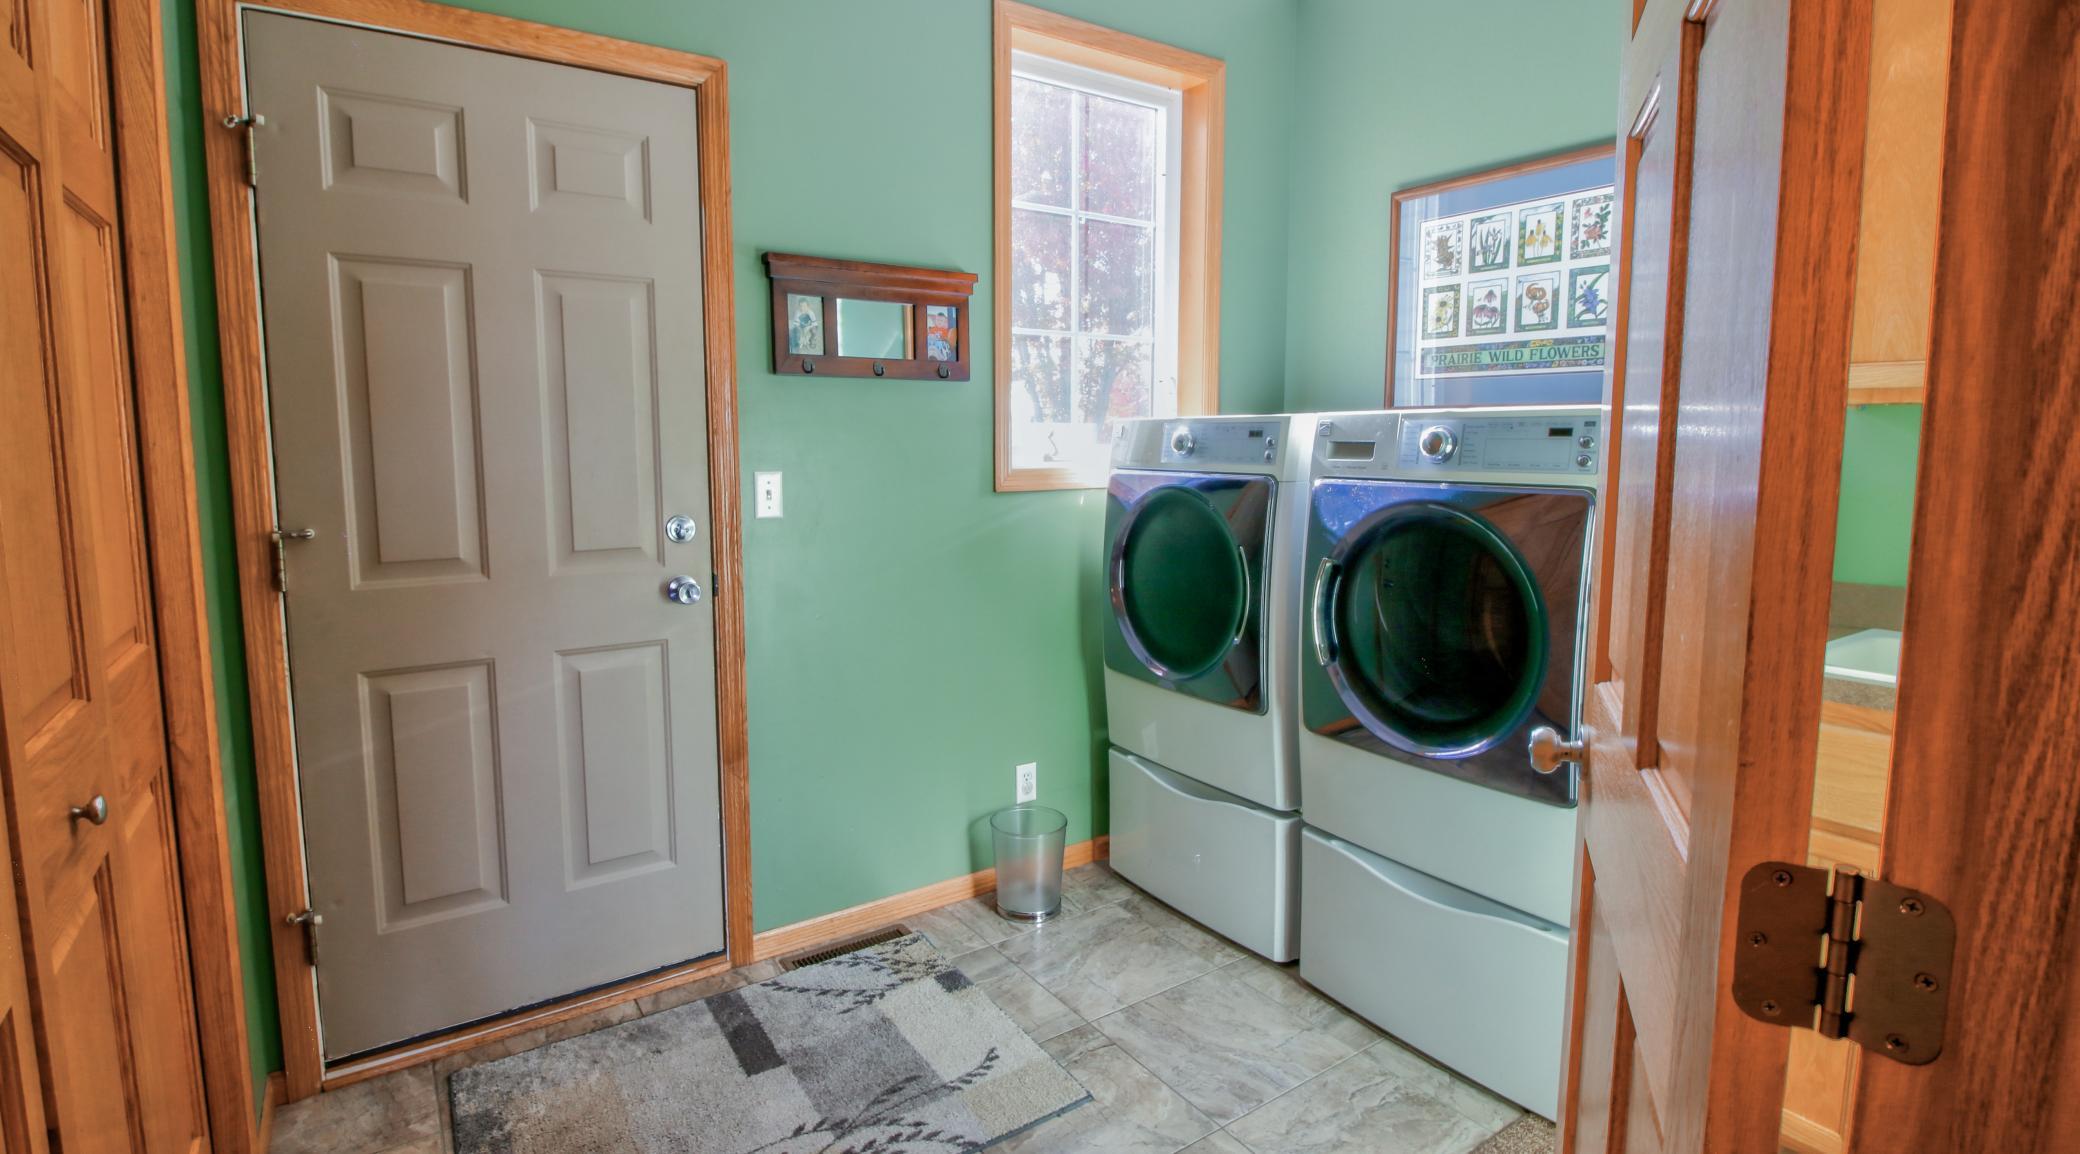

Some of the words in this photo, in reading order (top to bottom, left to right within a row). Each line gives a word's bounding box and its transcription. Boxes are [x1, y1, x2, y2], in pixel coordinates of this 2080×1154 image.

[1431, 352, 1482, 366] PRAIRIE
[1488, 348, 1524, 363] WILD
[1529, 344, 1600, 361] FLOWERS
